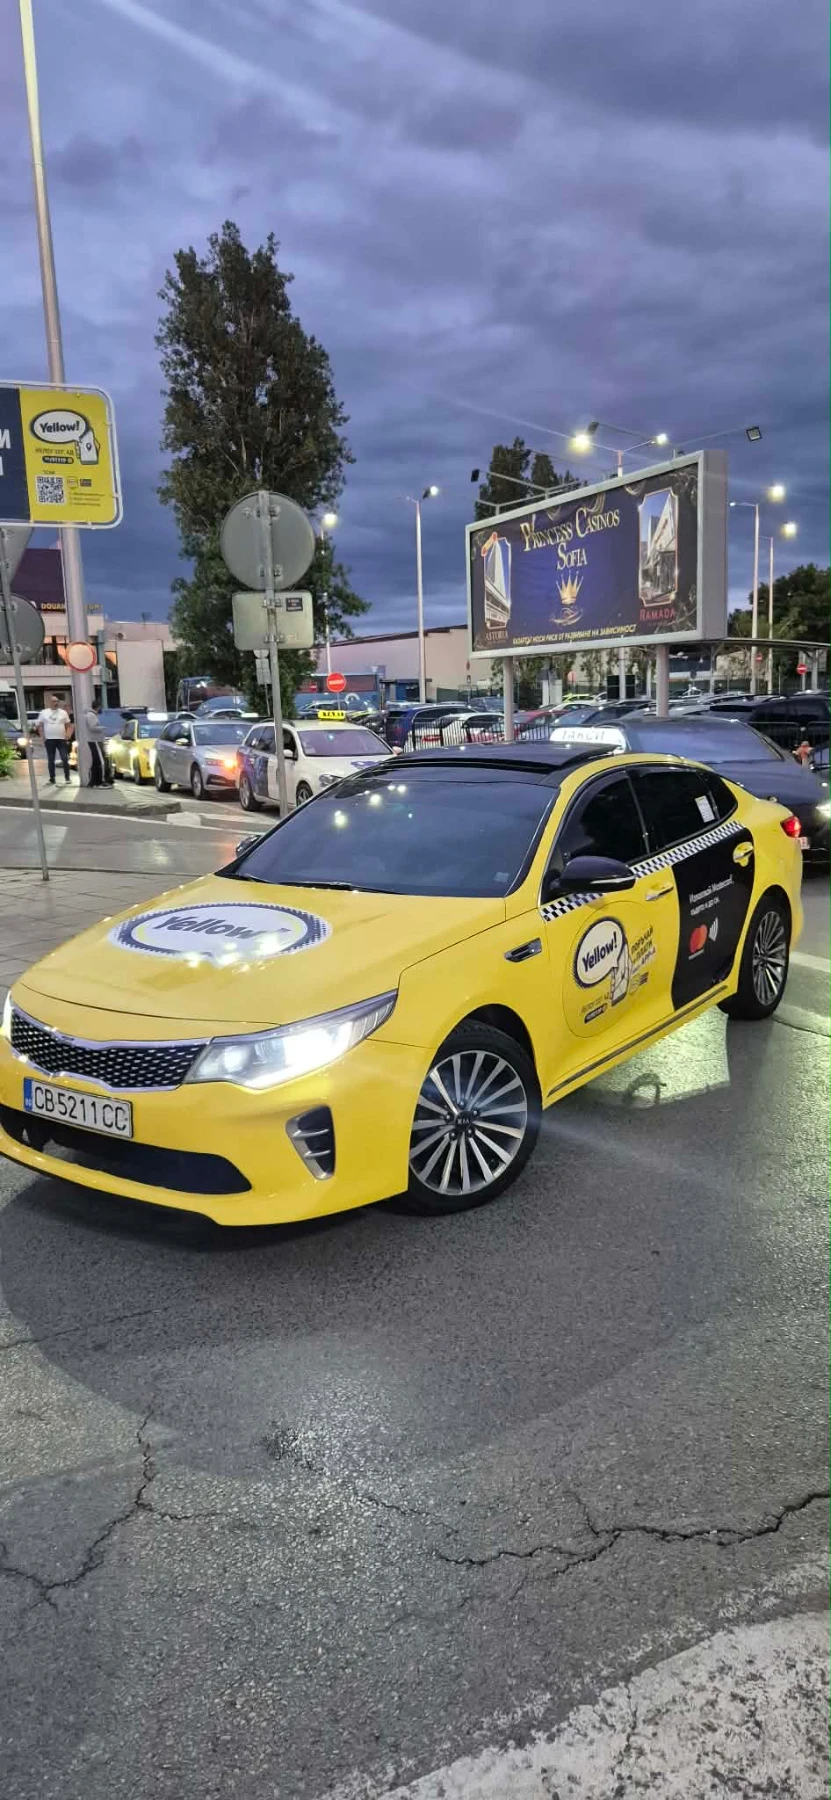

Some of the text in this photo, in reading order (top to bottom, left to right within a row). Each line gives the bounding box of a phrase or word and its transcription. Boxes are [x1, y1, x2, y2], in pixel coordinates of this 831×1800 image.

[39, 420, 81, 434] Yellow!
[519, 506, 620, 552] PRINCESS CASINOS
[556, 542, 588, 571] SOFIA
[639, 607, 676, 621] RAMADA
[581, 931, 618, 973] Yellow!
